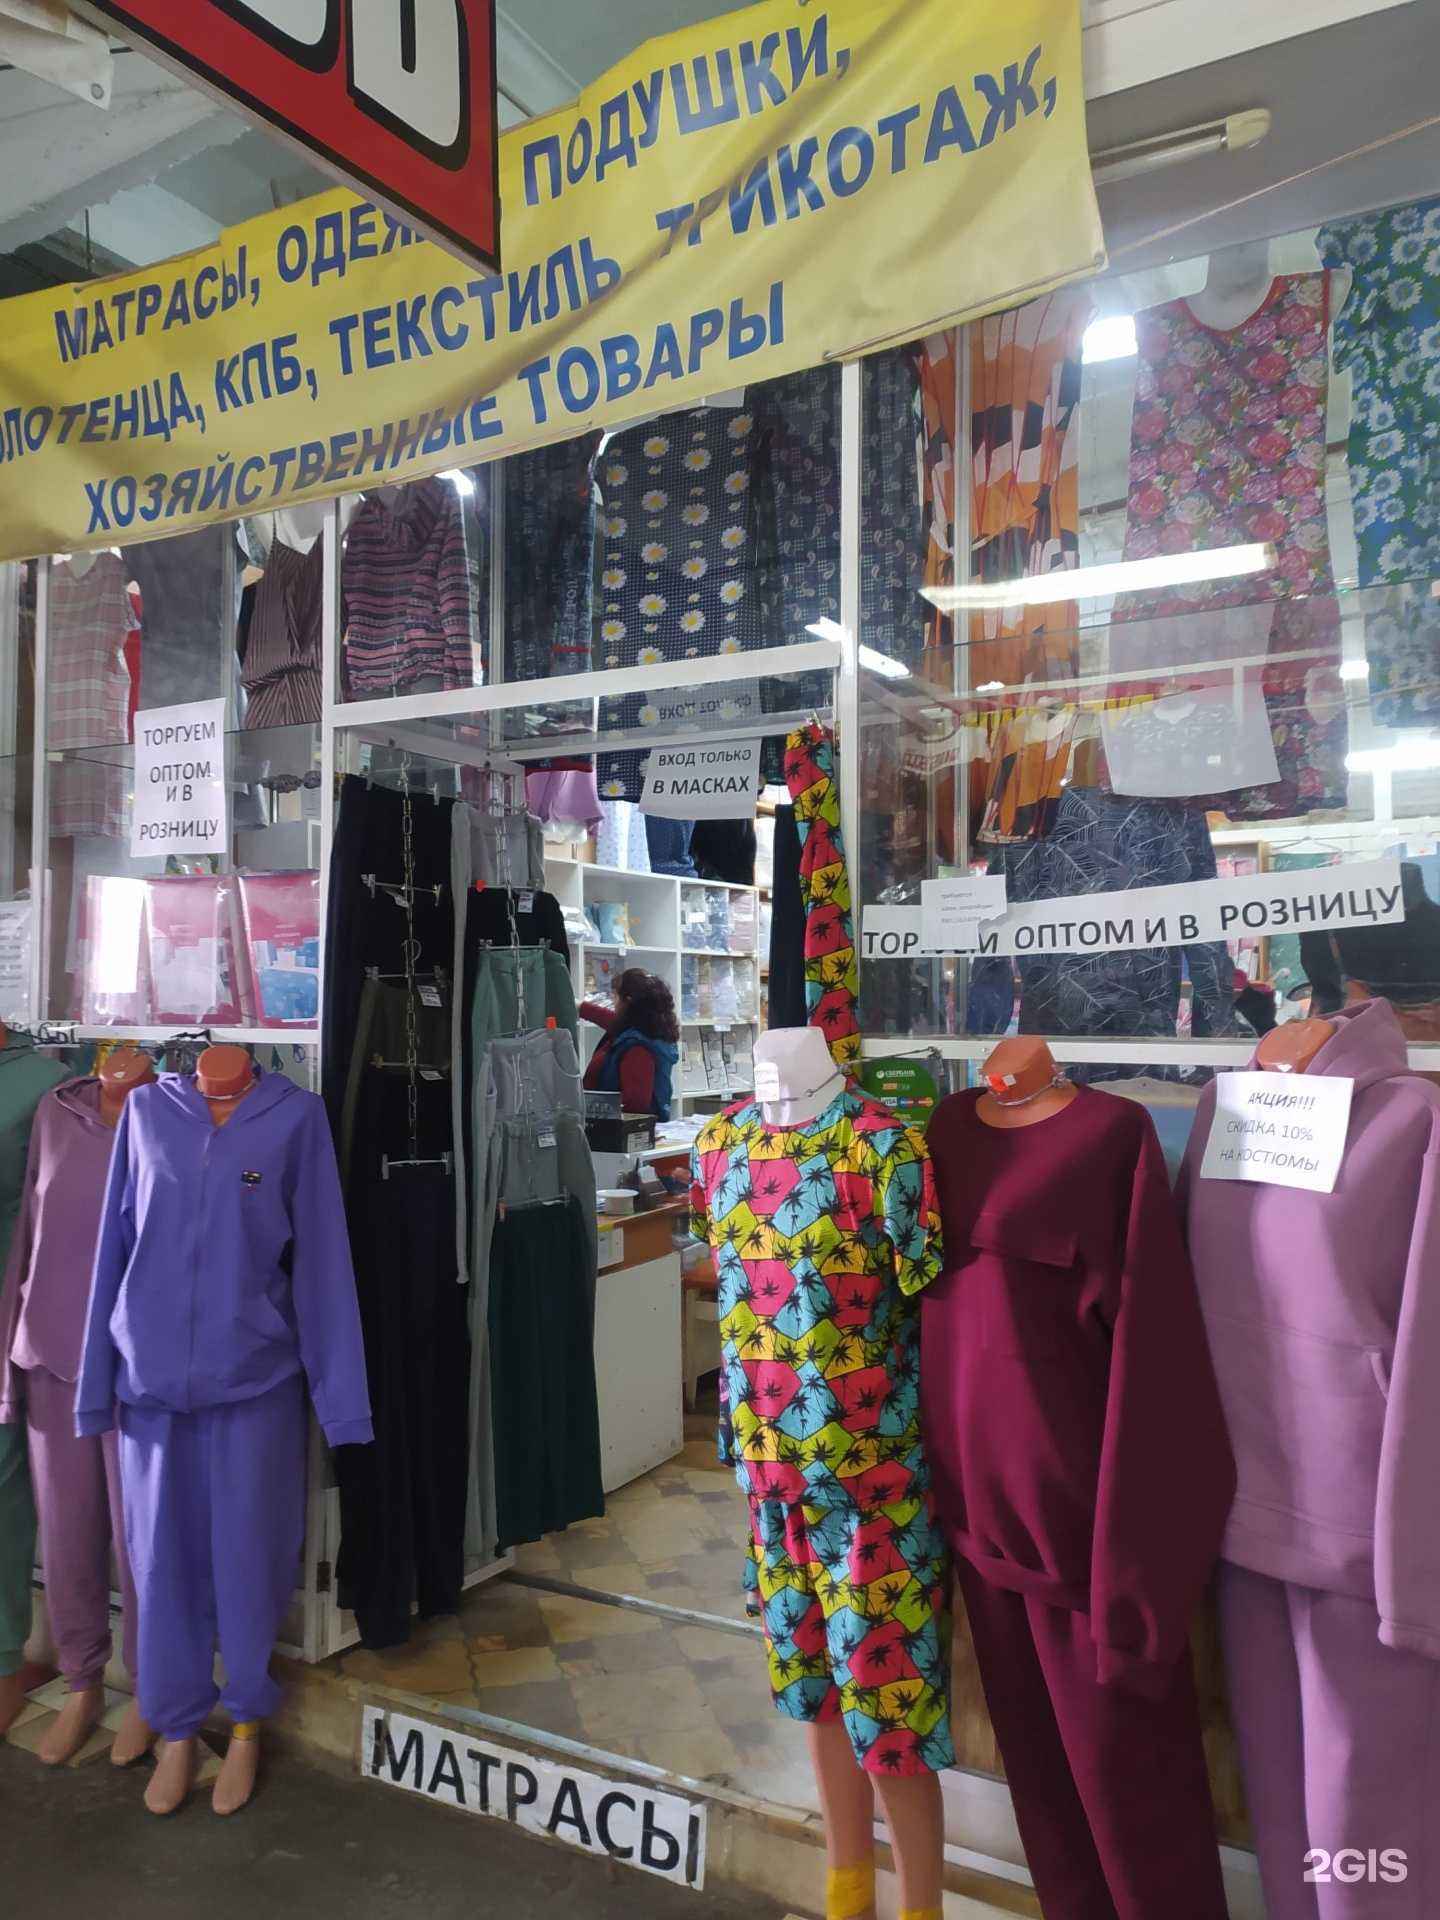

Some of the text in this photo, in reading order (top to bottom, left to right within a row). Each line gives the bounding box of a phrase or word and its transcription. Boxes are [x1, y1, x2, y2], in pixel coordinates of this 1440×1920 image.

[54, 244, 260, 363] МАТРАСЫ,
[523, 13, 850, 206] ПОДУШКИ,
[214, 333, 318, 413] КПБ,
[329, 236, 622, 376] ТЕКСТИЛЬ
[655, 43, 1057, 258] ТРИКОТАЖ,
[84, 279, 784, 534] ХОЗЯЙСТВЕННЫЕ ТОВАРЫ
[143, 721, 216, 747] ТОРГУЕМ
[658, 749, 751, 766] ВХОД ТОЛЬКО
[149, 760, 212, 785] ОПТОМ
[166, 784, 193, 802] И В
[653, 776, 750, 796] В МАСКАХ
[139, 818, 219, 842] РОЗНИЦУ
[1014, 918, 1135, 950] ОПТОМ
[1144, 917, 1167, 943] И
[1179, 914, 1200, 940] В
[1219, 885, 1401, 931] РОЗНИЦУ
[1247, 1090, 1316, 1111] АКЦИЯ!!!
[1226, 1119, 1314, 1141] СКИДКА 10%
[1219, 1148, 1320, 1172] НА КОСТЮМЫ
[372, 1717, 700, 1883] МАТРАСЫ
